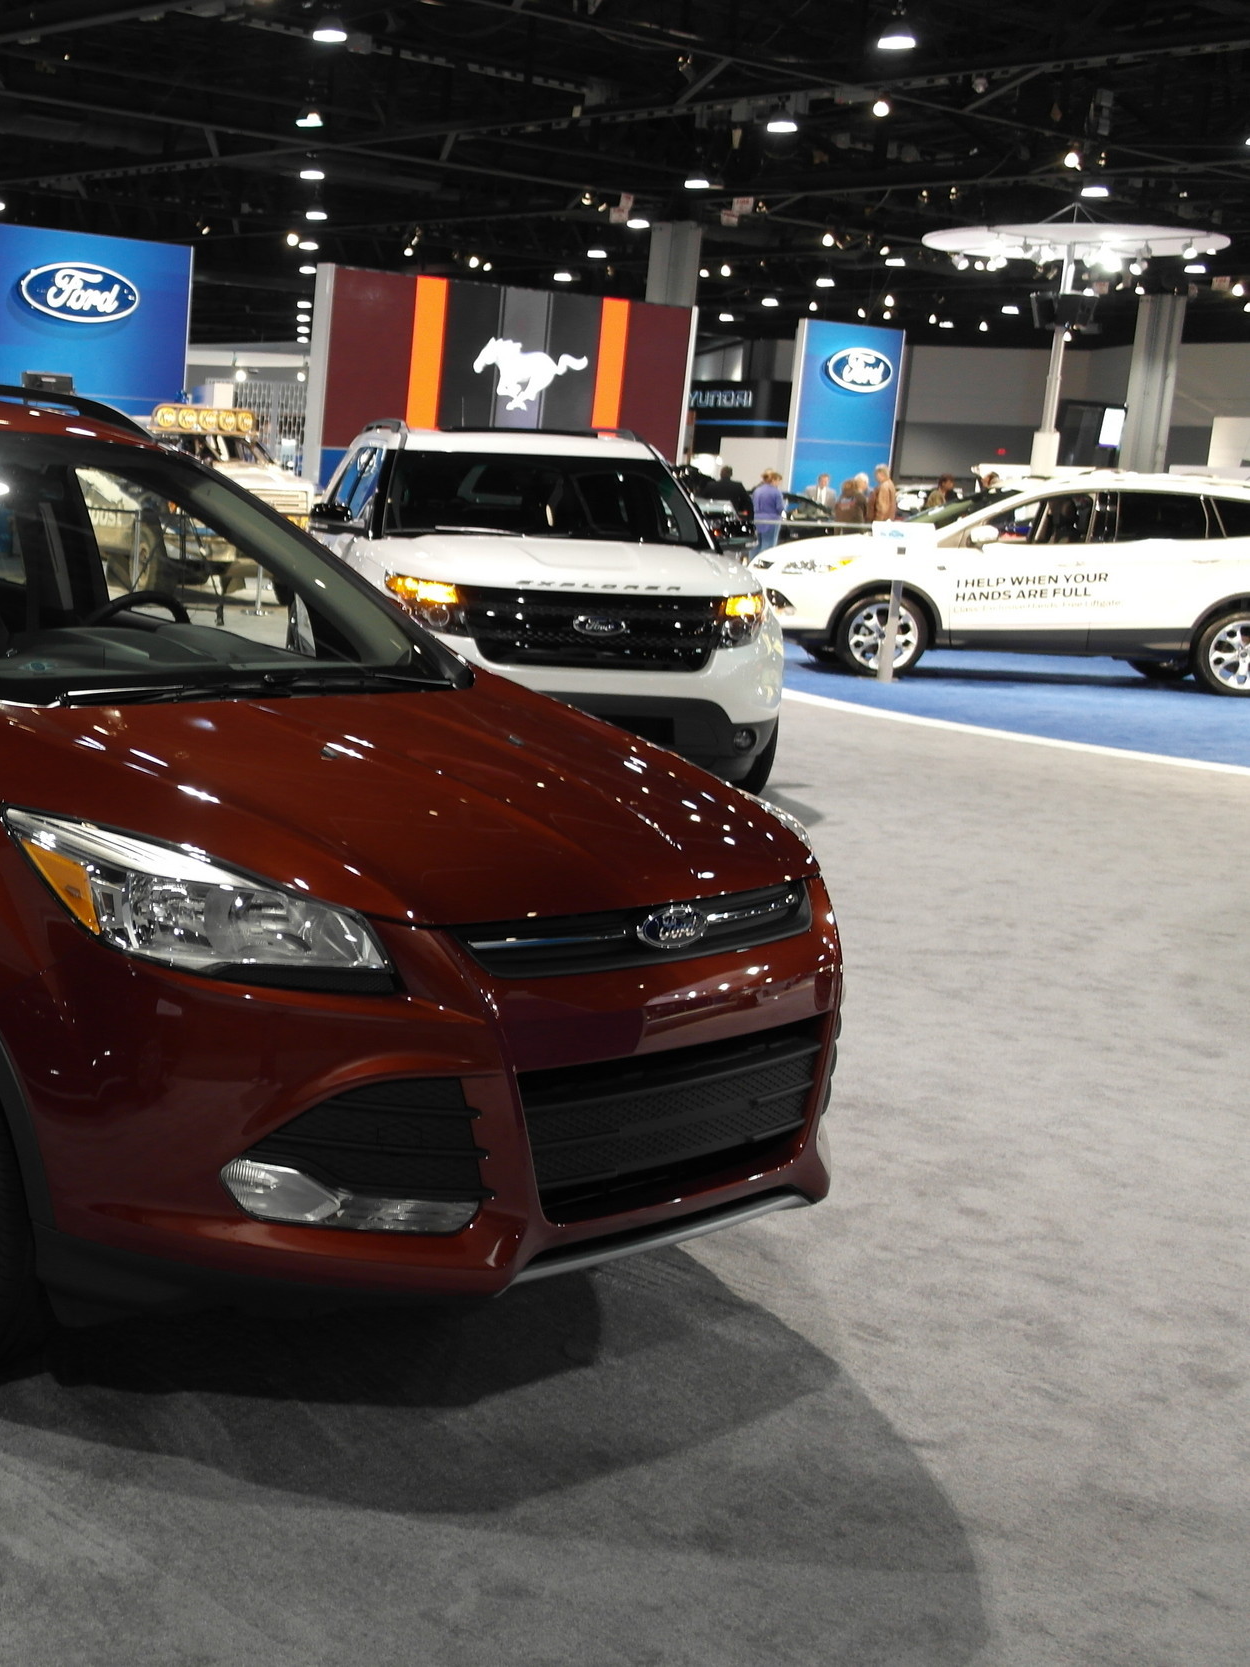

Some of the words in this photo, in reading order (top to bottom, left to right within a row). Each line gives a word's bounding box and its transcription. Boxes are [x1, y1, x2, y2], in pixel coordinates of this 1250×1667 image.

[46, 268, 120, 313] Ford
[842, 352, 885, 385] Ford
[689, 390, 753, 408] YUNDAI
[516, 580, 681, 591] EXPLORER
[956, 579, 961, 588] I
[964, 577, 1006, 588] HELP
[1010, 575, 1059, 586] WHEN
[1063, 572, 1109, 584] YOUR
[955, 590, 1012, 602] HANDS
[1016, 588, 1049, 600] ARE
[1052, 587, 1092, 598] FULL
[658, 910, 697, 941] Ford
